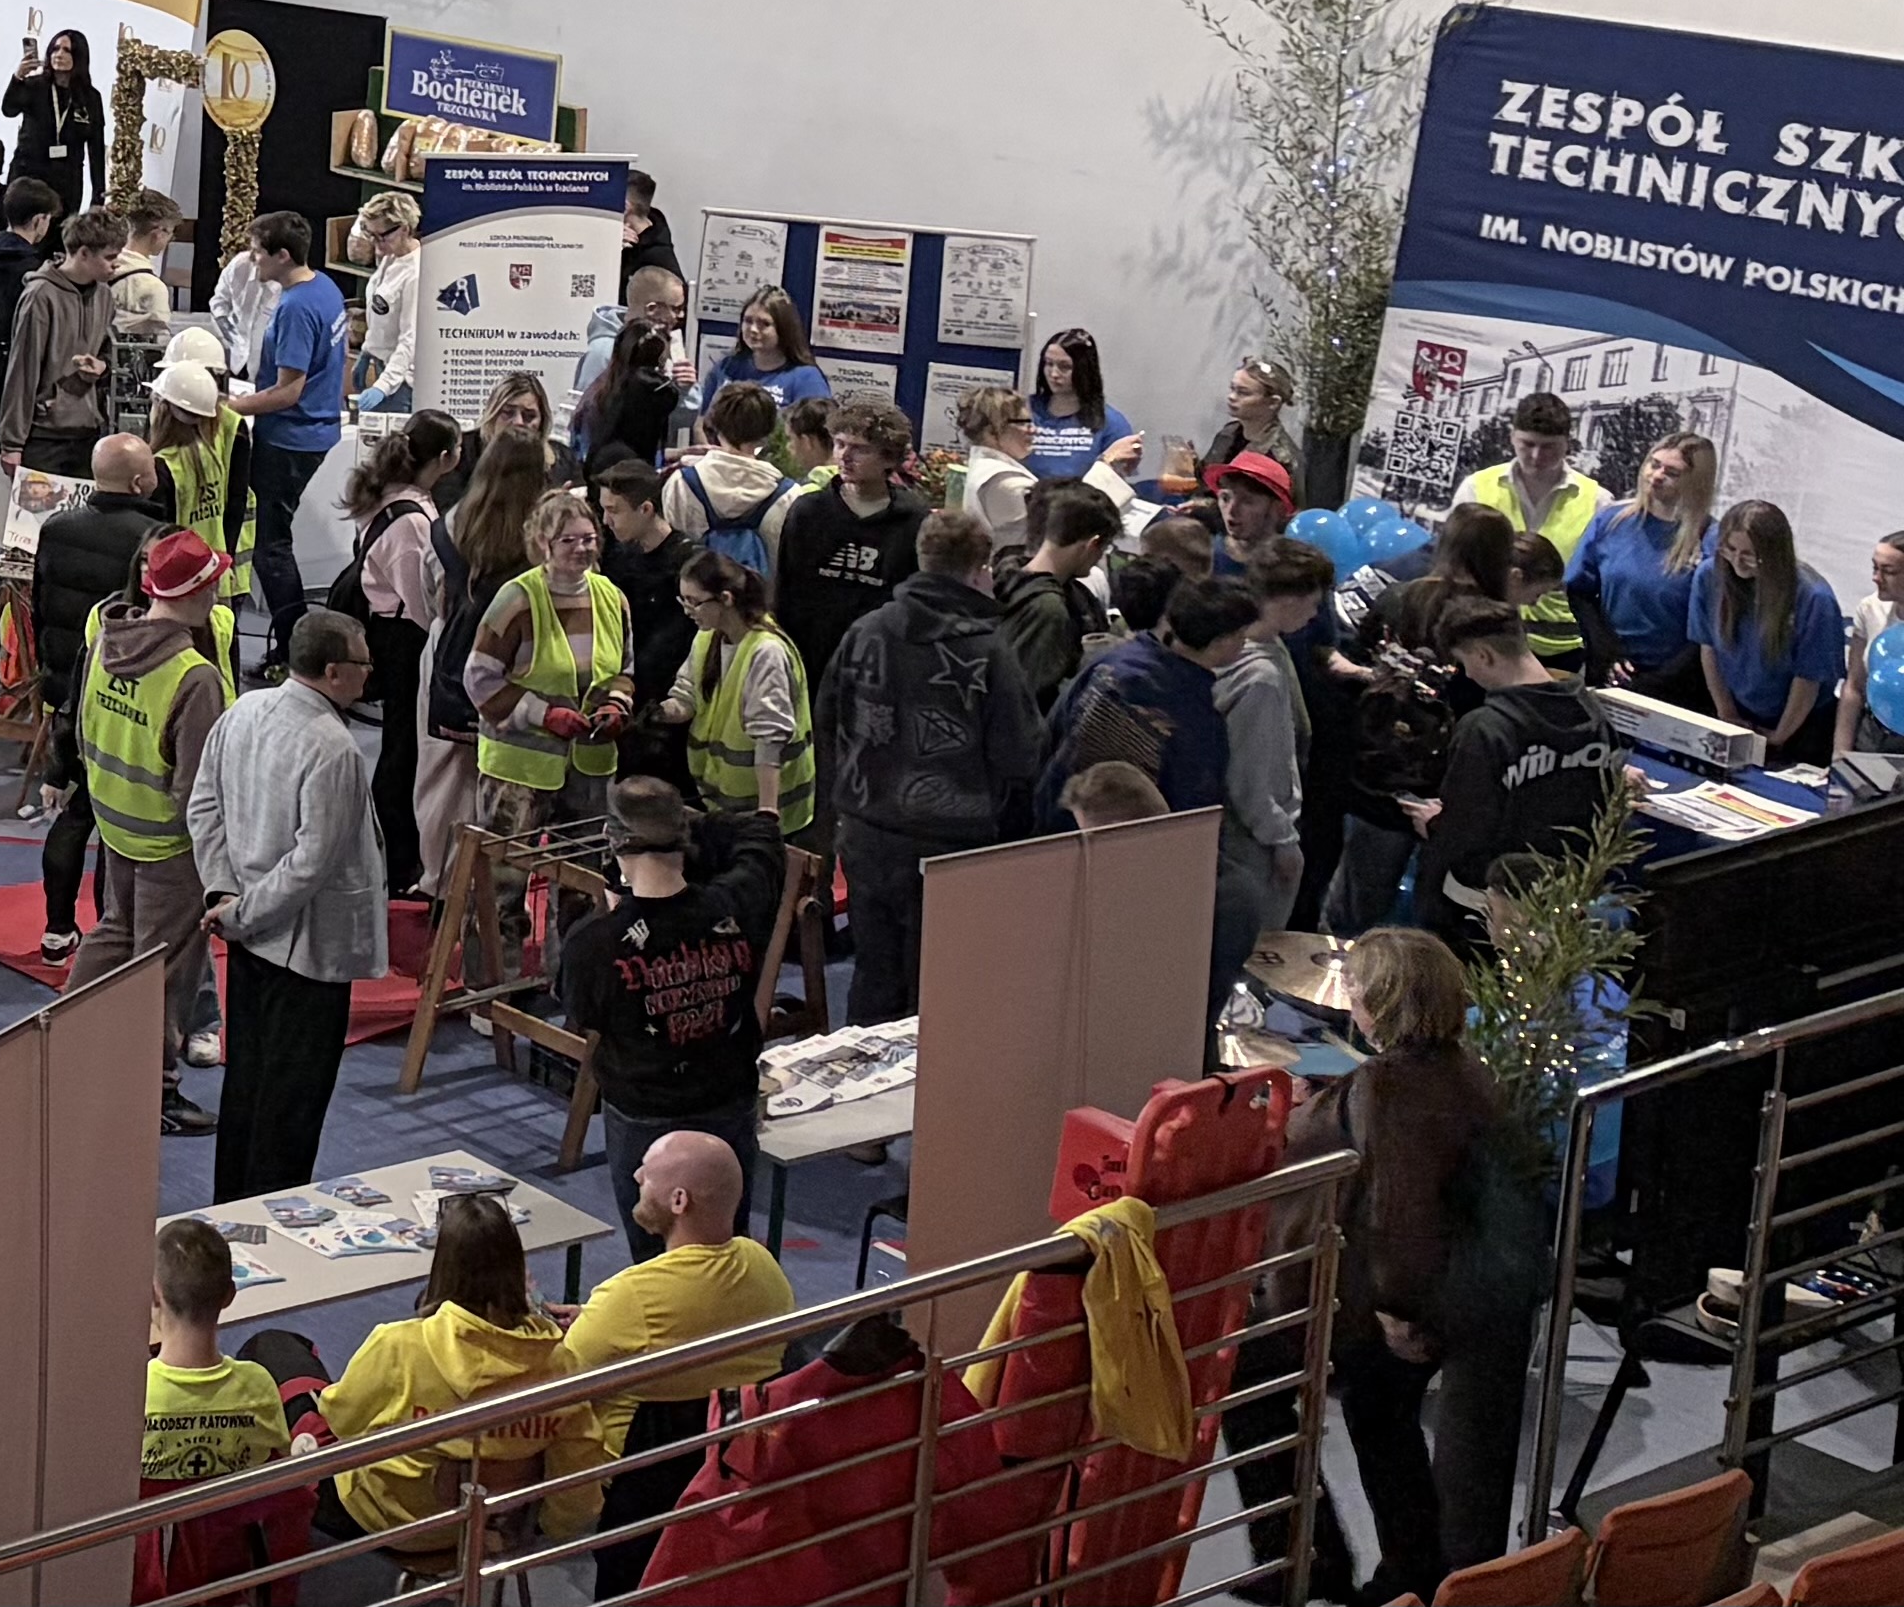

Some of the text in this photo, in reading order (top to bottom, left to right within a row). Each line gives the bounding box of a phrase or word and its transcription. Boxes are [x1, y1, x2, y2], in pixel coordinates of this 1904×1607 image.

[411, 70, 527, 116] Bochenek
[436, 101, 497, 123] TRZCIANKA
[1493, 79, 1904, 183] ZESPÓŁ SZK
[444, 168, 609, 182] ZESPÓŁ SZKÓŁ TECHNICZNYCH
[1488, 132, 1904, 242] TECHNICZNY
[1479, 214, 1904, 315] IM. NOBLISTÓW POLSKICH
[438, 328, 505, 340] TECHNIKUM
[519, 328, 580, 341] zawodach:
[199, 1414, 256, 1429] RATOWNIK
